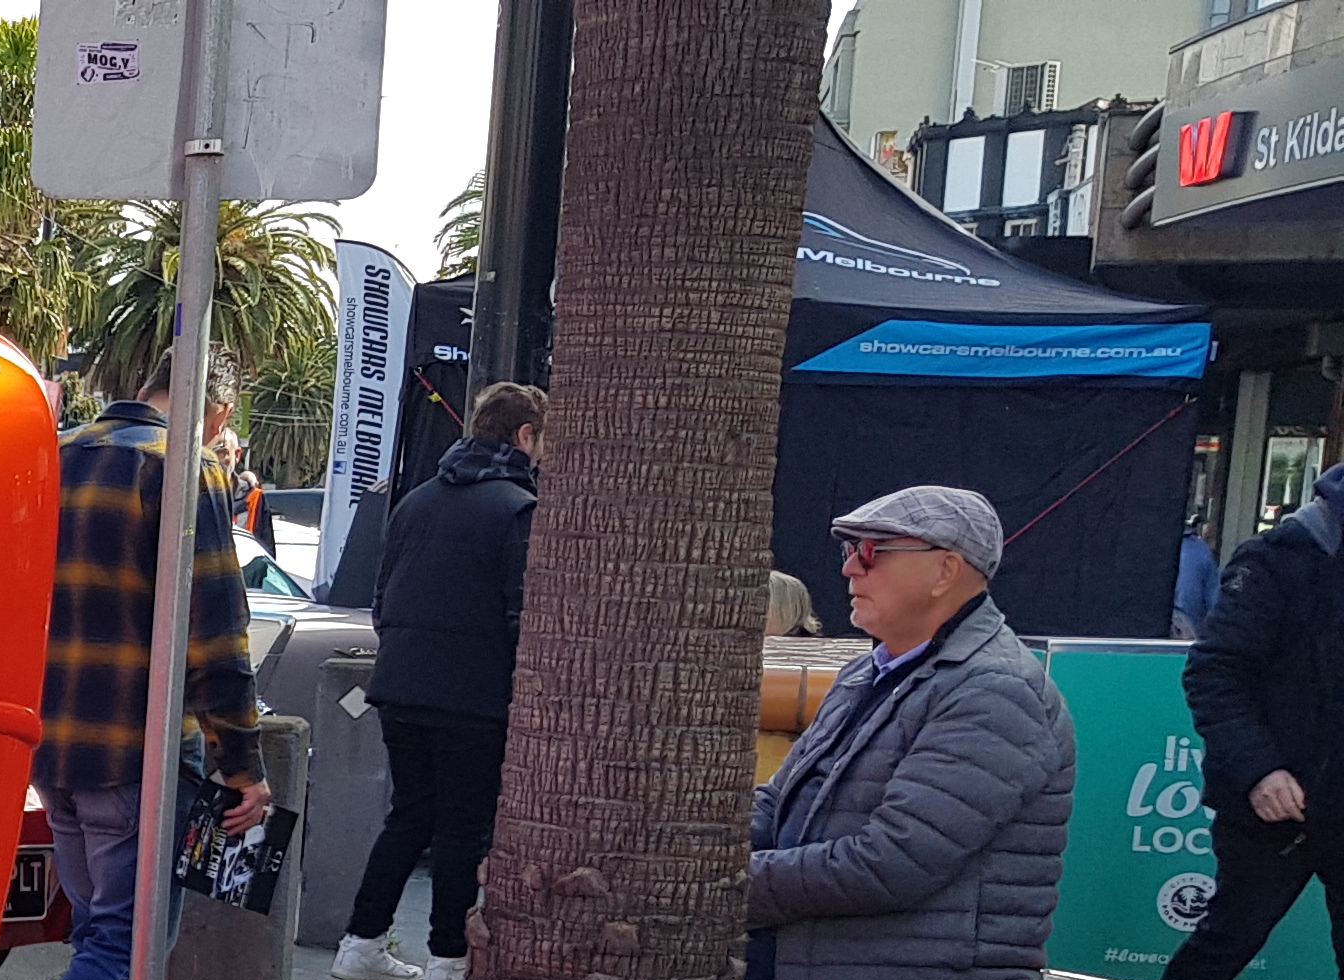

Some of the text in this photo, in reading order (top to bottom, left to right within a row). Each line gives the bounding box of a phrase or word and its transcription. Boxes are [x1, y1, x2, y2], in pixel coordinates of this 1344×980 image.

[1254, 125, 1280, 169] St
[1284, 106, 1344, 163] Kilda
[796, 246, 1000, 287] Melbourne
[361, 264, 391, 382] SHOWCARS
[860, 341, 1182, 358] showcarsmelbourne.com.au
[337, 296, 358, 455] showcarsmelbourne.com.au
